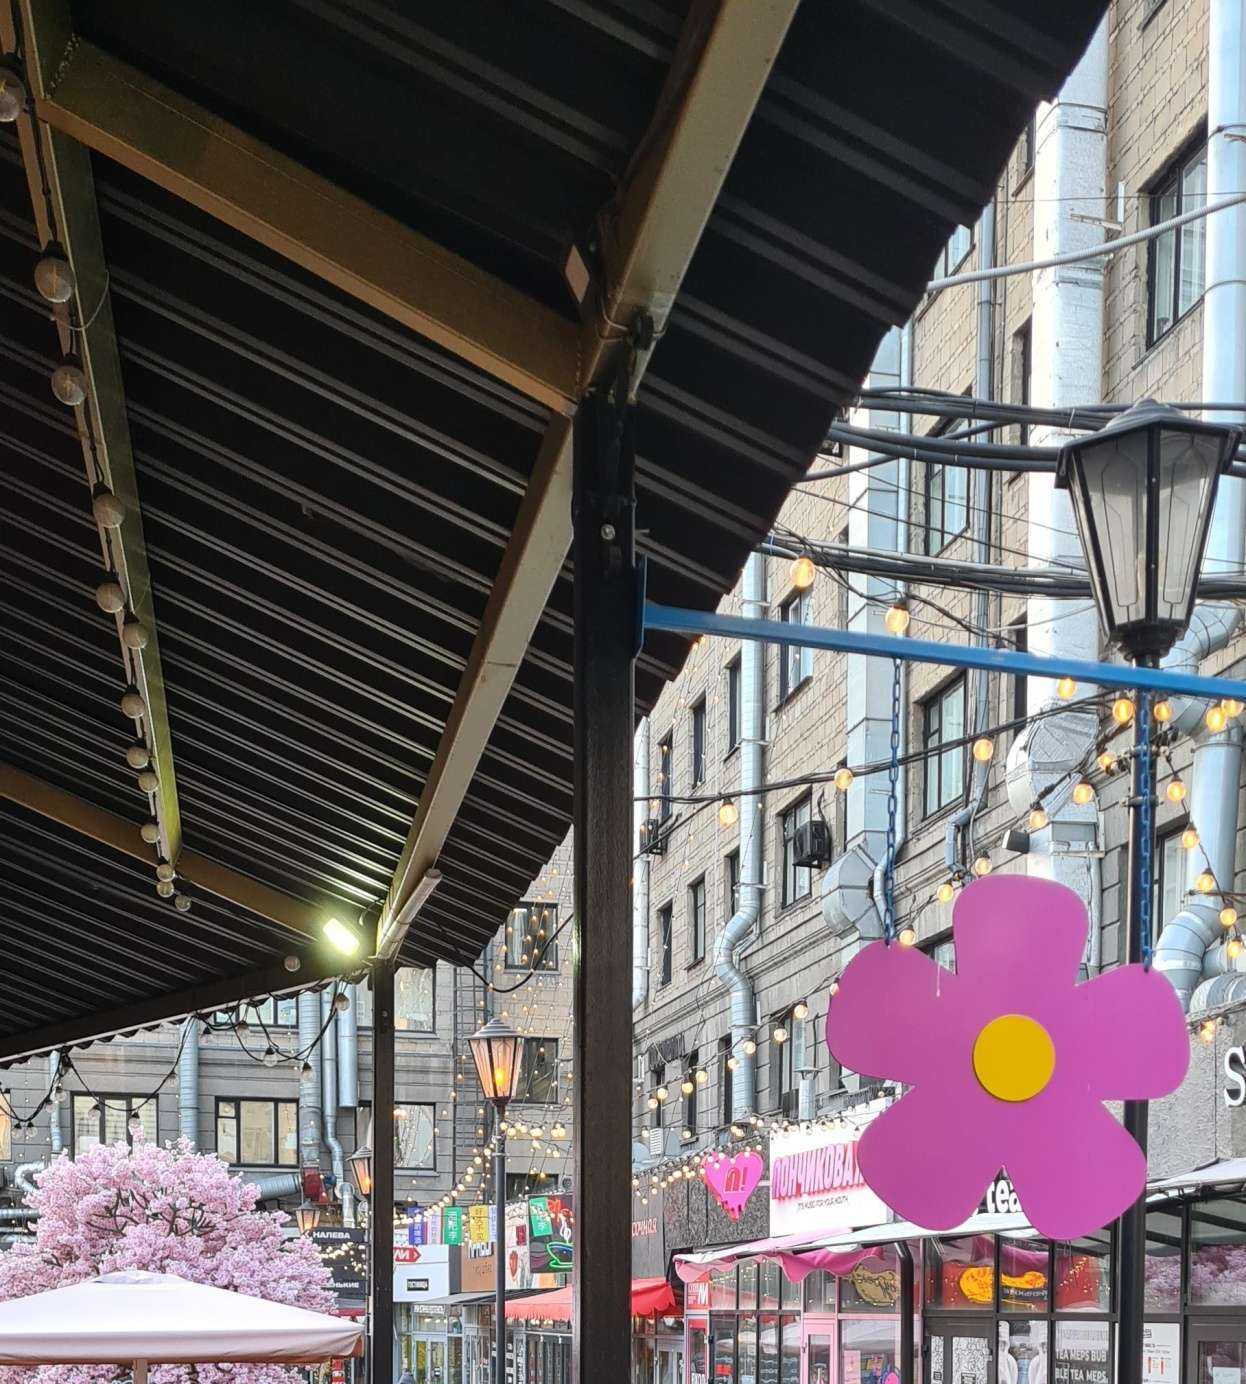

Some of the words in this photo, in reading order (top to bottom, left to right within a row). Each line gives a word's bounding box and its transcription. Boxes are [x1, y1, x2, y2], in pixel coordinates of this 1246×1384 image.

[1056, 1349, 1069, 1360] TEA
[1070, 1350, 1089, 1361] MEPS
[1091, 1350, 1106, 1362] BUB
[1055, 1368, 1068, 1379] BLE
[1070, 1368, 1084, 1380] TEA
[1086, 1370, 1106, 1382] MEPS
